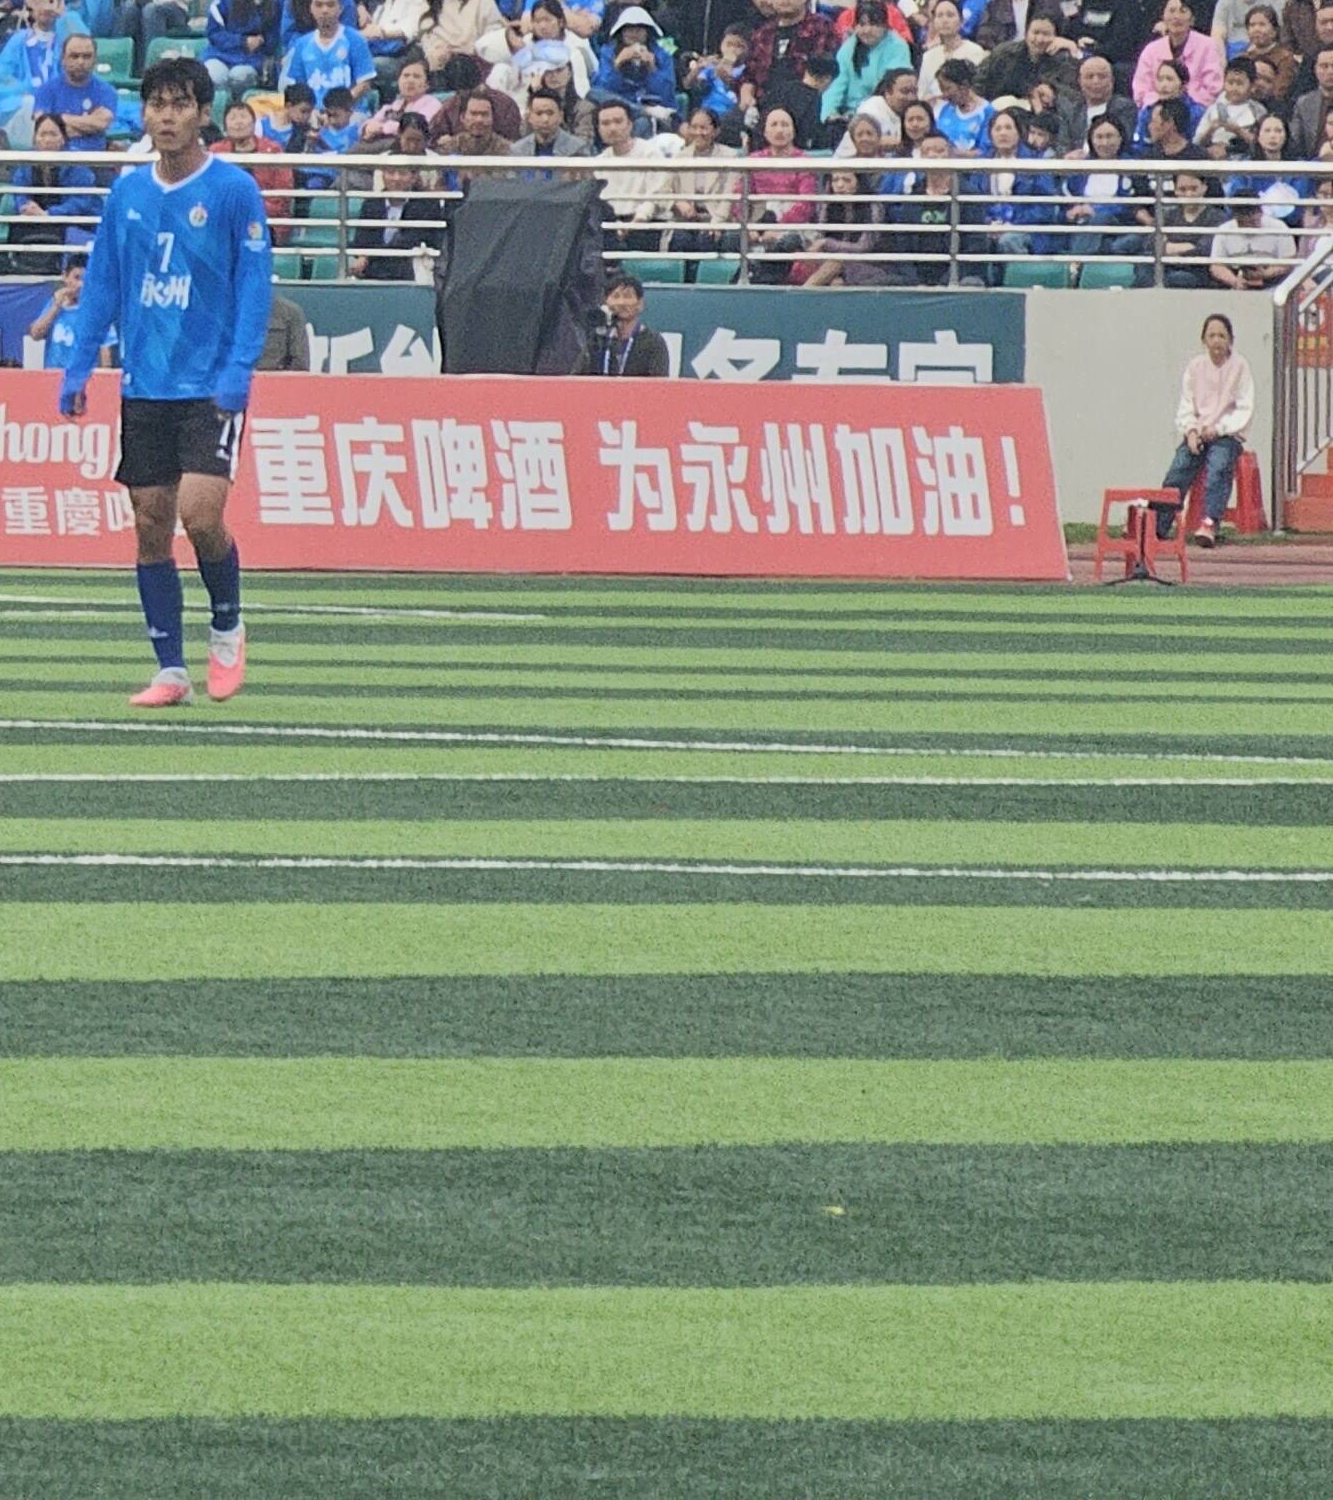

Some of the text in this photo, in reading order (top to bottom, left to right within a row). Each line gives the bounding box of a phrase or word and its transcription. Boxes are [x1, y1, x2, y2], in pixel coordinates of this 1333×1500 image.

[157, 232, 174, 274] 7
[251, 414, 1027, 538] 重庆啤酒 为永州加油！
